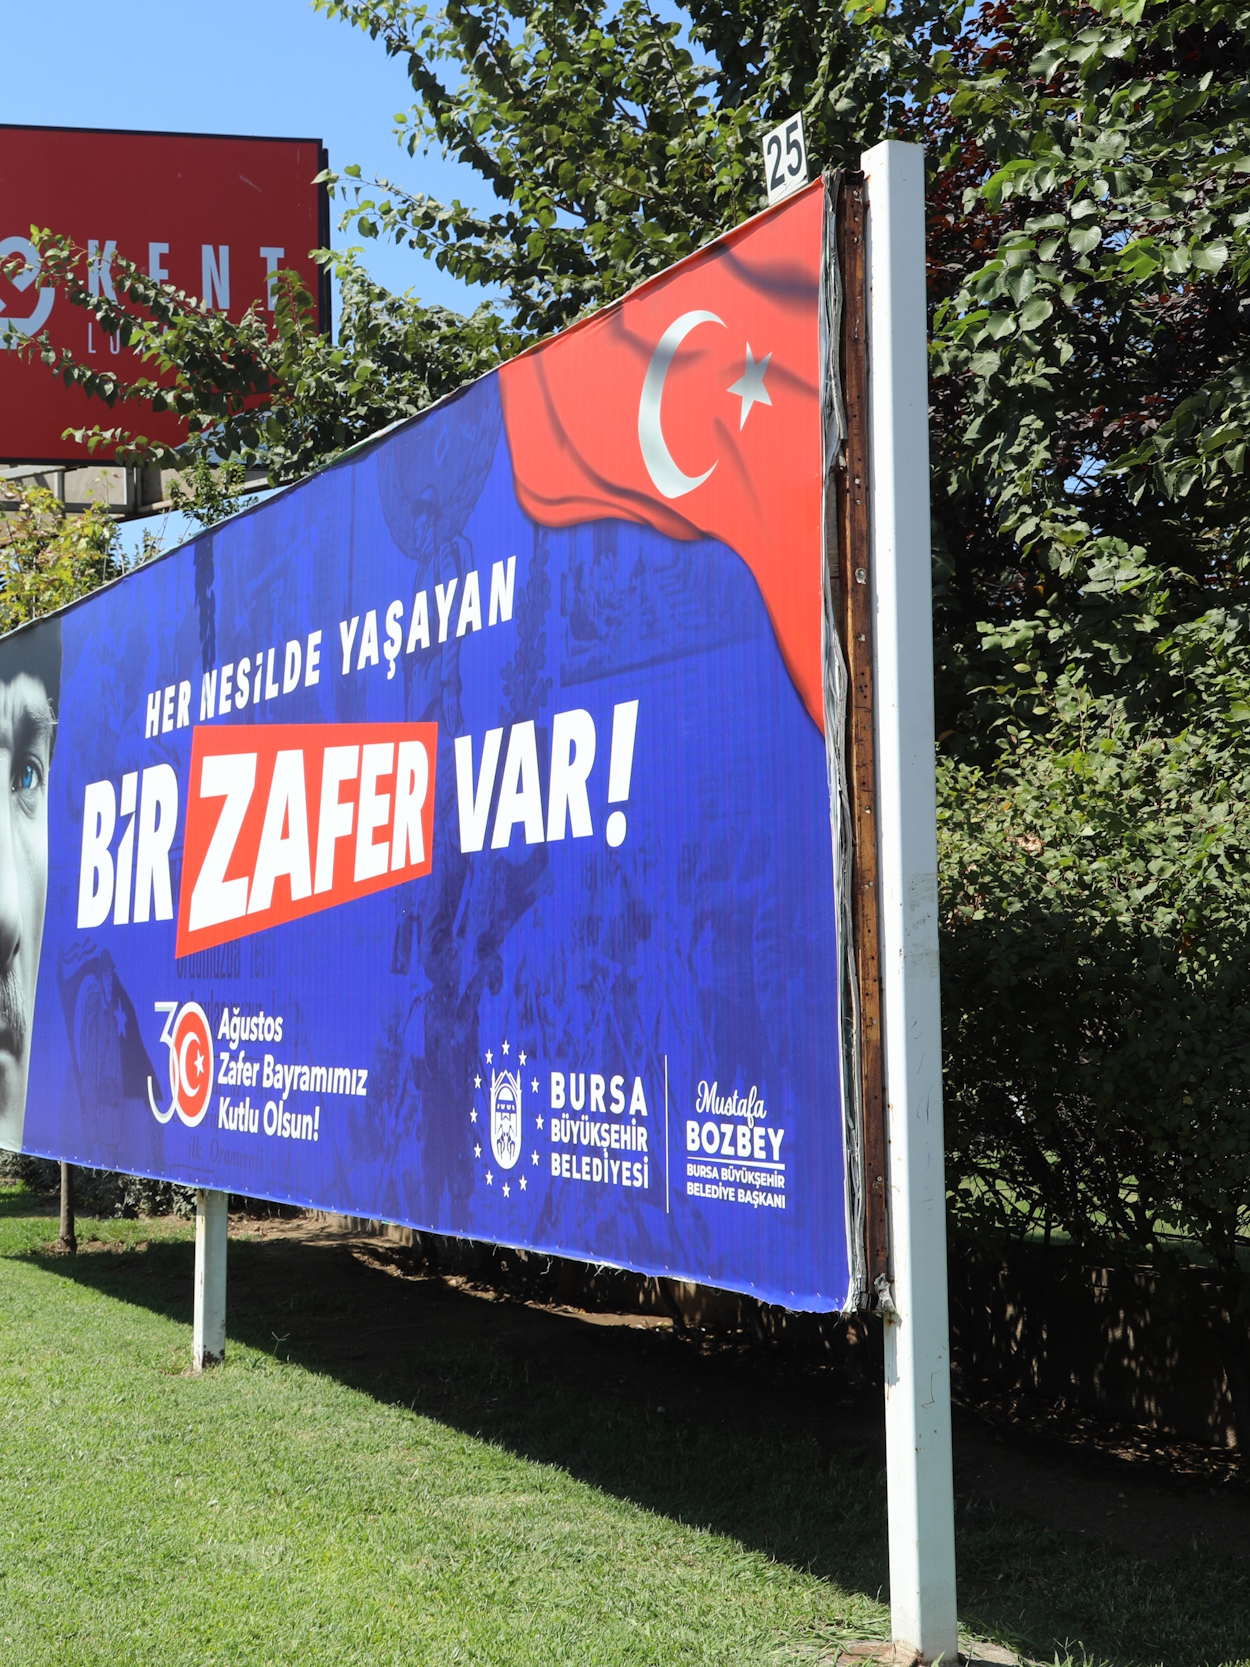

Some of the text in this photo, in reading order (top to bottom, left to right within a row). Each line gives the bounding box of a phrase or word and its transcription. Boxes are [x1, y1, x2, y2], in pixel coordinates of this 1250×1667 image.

[766, 119, 803, 192] 25
[87, 239, 285, 312] KENT
[145, 555, 518, 739] HER NESİLDE YAŞAYAN
[76, 699, 640, 933] BİR ZAFER VAR!
[217, 1007, 284, 1050] Ağustos
[147, 1001, 215, 1128] 30
[217, 1051, 369, 1100] Zafer Bayramımız
[550, 1071, 649, 1117] BURSA
[695, 1079, 768, 1129] Mustafa
[218, 1097, 320, 1142] Kutlu Olsun!
[550, 1113, 649, 1153] BÜYÜKŞEHİR
[686, 1120, 785, 1162] BOZBEY
[550, 1147, 650, 1190] BELEDİYESİ
[686, 1163, 786, 1190] BURSA BÜYÜKŞEHİR
[686, 1180, 786, 1210] BELEDİYE BAŞKANI
